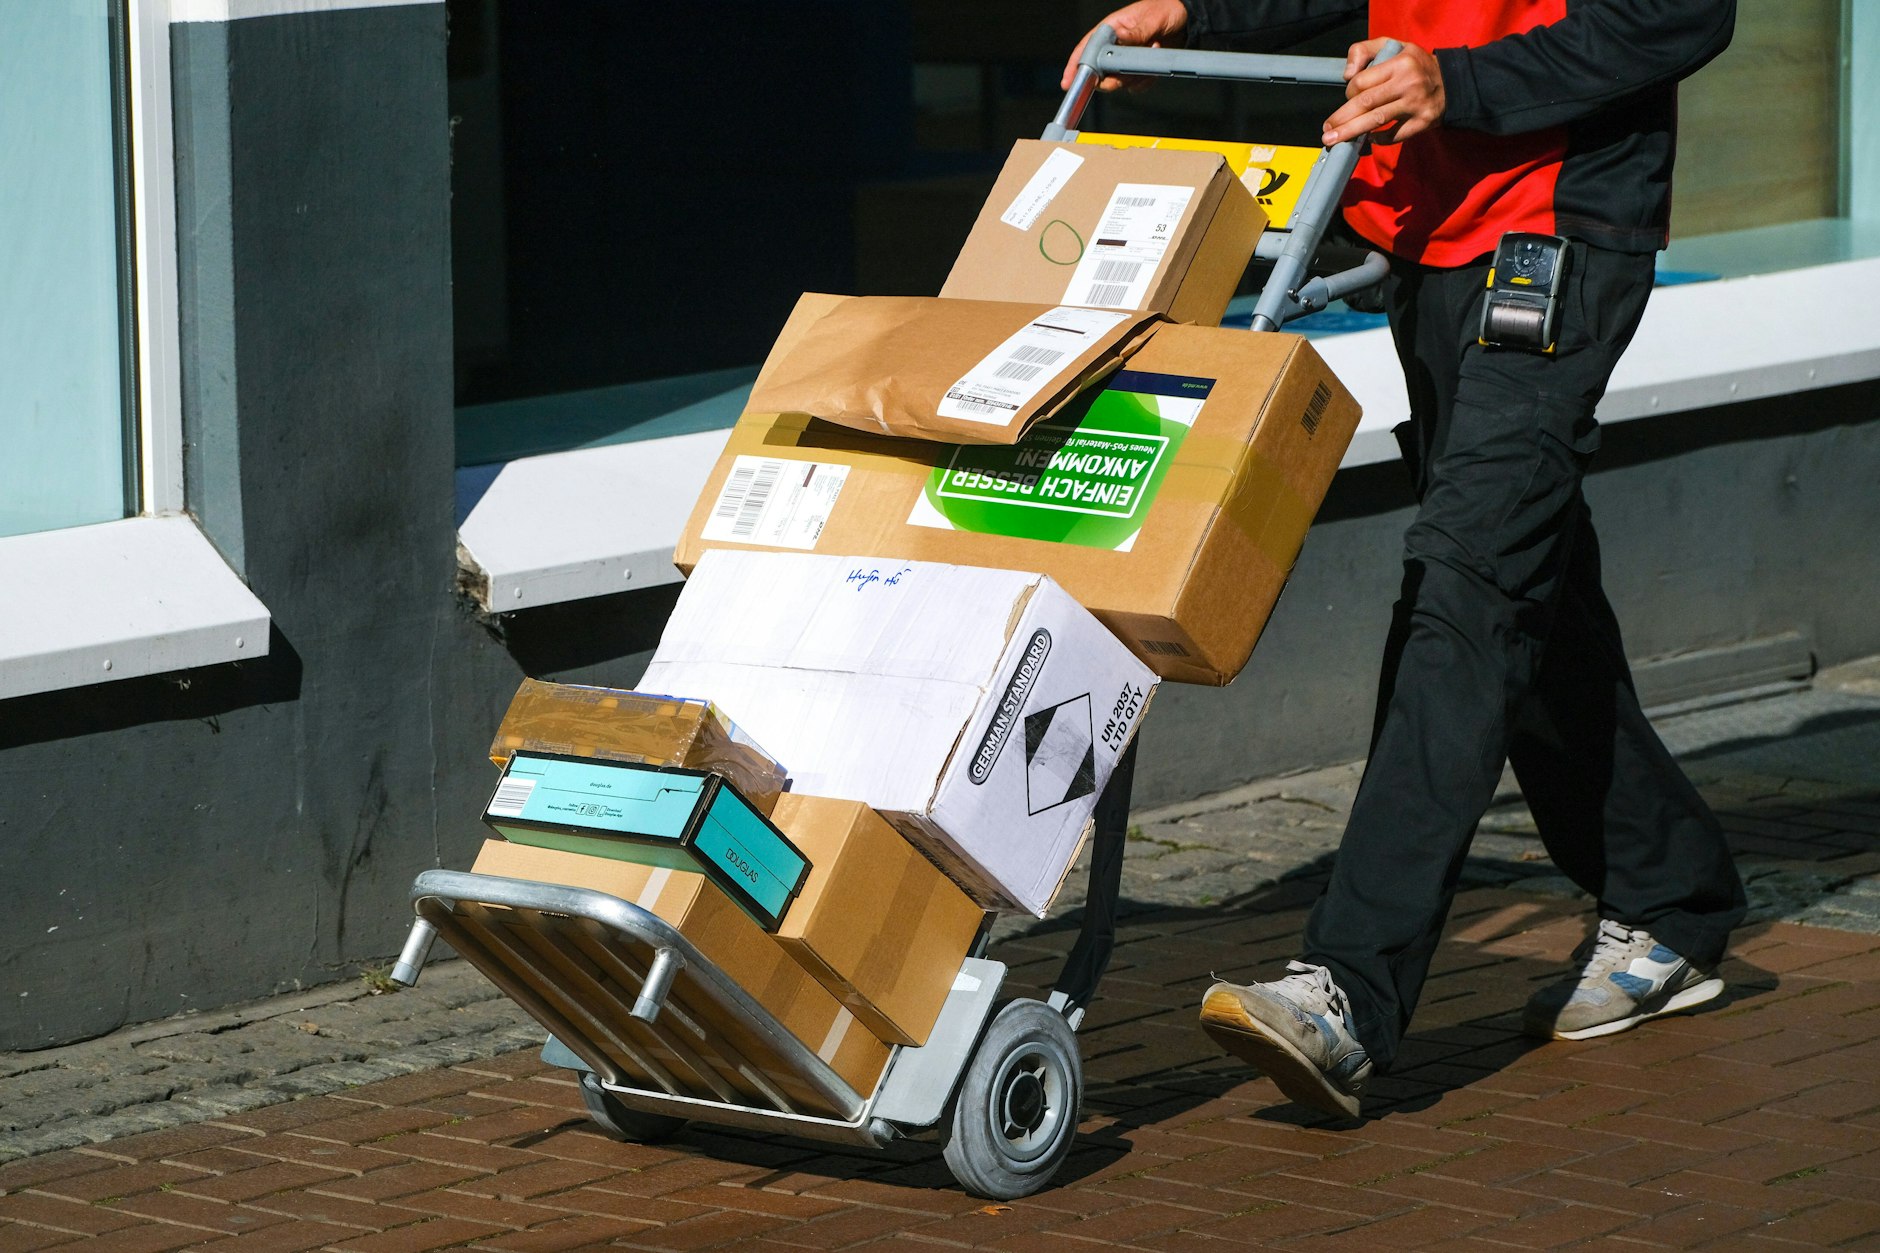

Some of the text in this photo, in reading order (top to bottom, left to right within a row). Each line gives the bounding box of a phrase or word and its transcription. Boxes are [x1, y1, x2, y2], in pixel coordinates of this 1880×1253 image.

[1155, 224, 1167, 233] 53
[1079, 437, 1129, 452] PoS-Material
[1130, 443, 1156, 454] Neues
[1015, 447, 1148, 479] ANKOMMEN!
[951, 465, 1135, 506] EINFACH BESSER
[972, 634, 1047, 779] GERMAN STANDARD
[1101, 681, 1133, 744] UN 2037
[1109, 686, 1144, 753] LTD QTY
[725, 848, 759, 884] DOUGLAS
